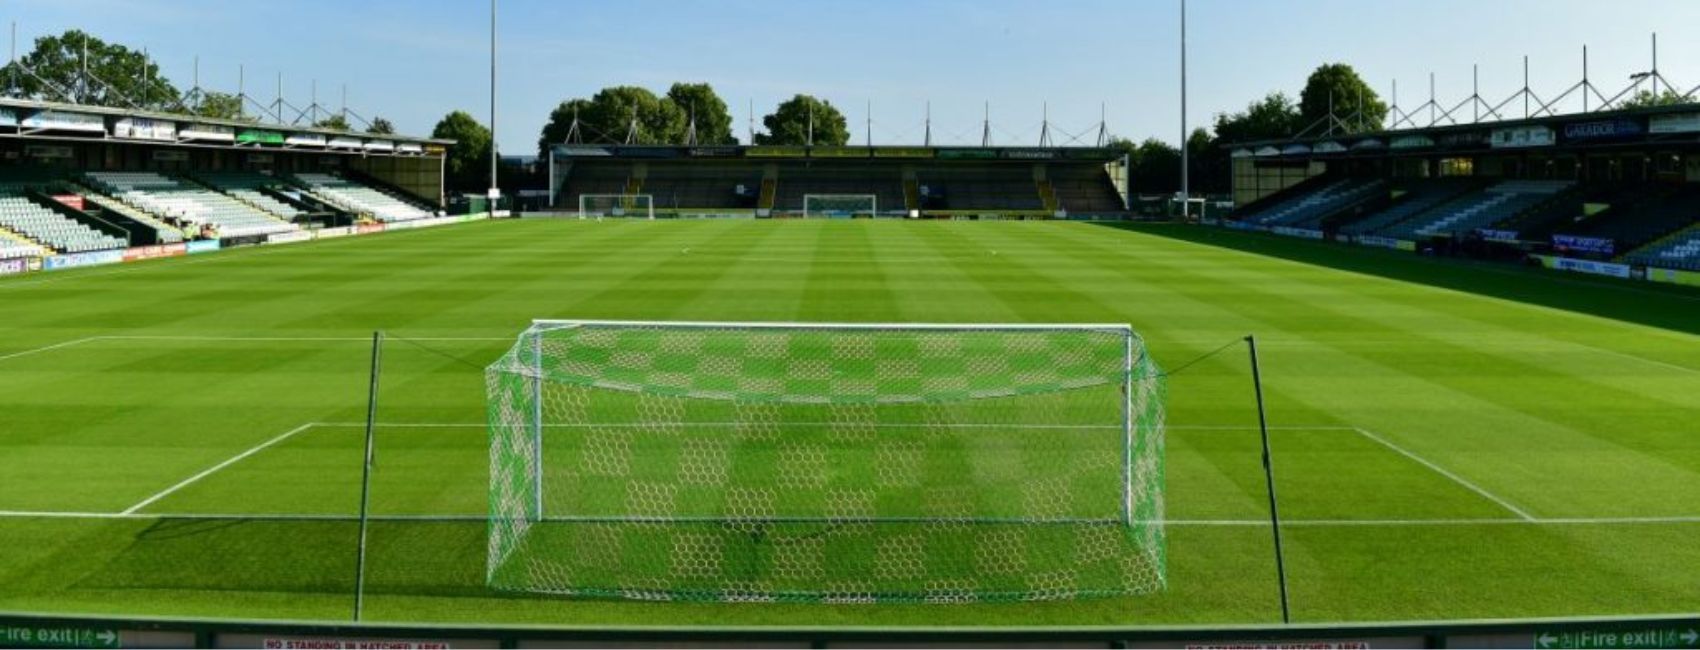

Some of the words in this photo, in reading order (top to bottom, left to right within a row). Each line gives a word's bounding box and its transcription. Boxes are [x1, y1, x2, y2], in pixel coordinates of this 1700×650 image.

[37, 628, 72, 643] exit
[1582, 631, 1616, 645] Fire
[1622, 631, 1656, 645] exit
[266, 640, 282, 650] NO
[287, 641, 341, 650] STANDING
[345, 641, 356, 650] IN
[360, 642, 411, 650] HATCHED
[418, 642, 446, 650] AREA
